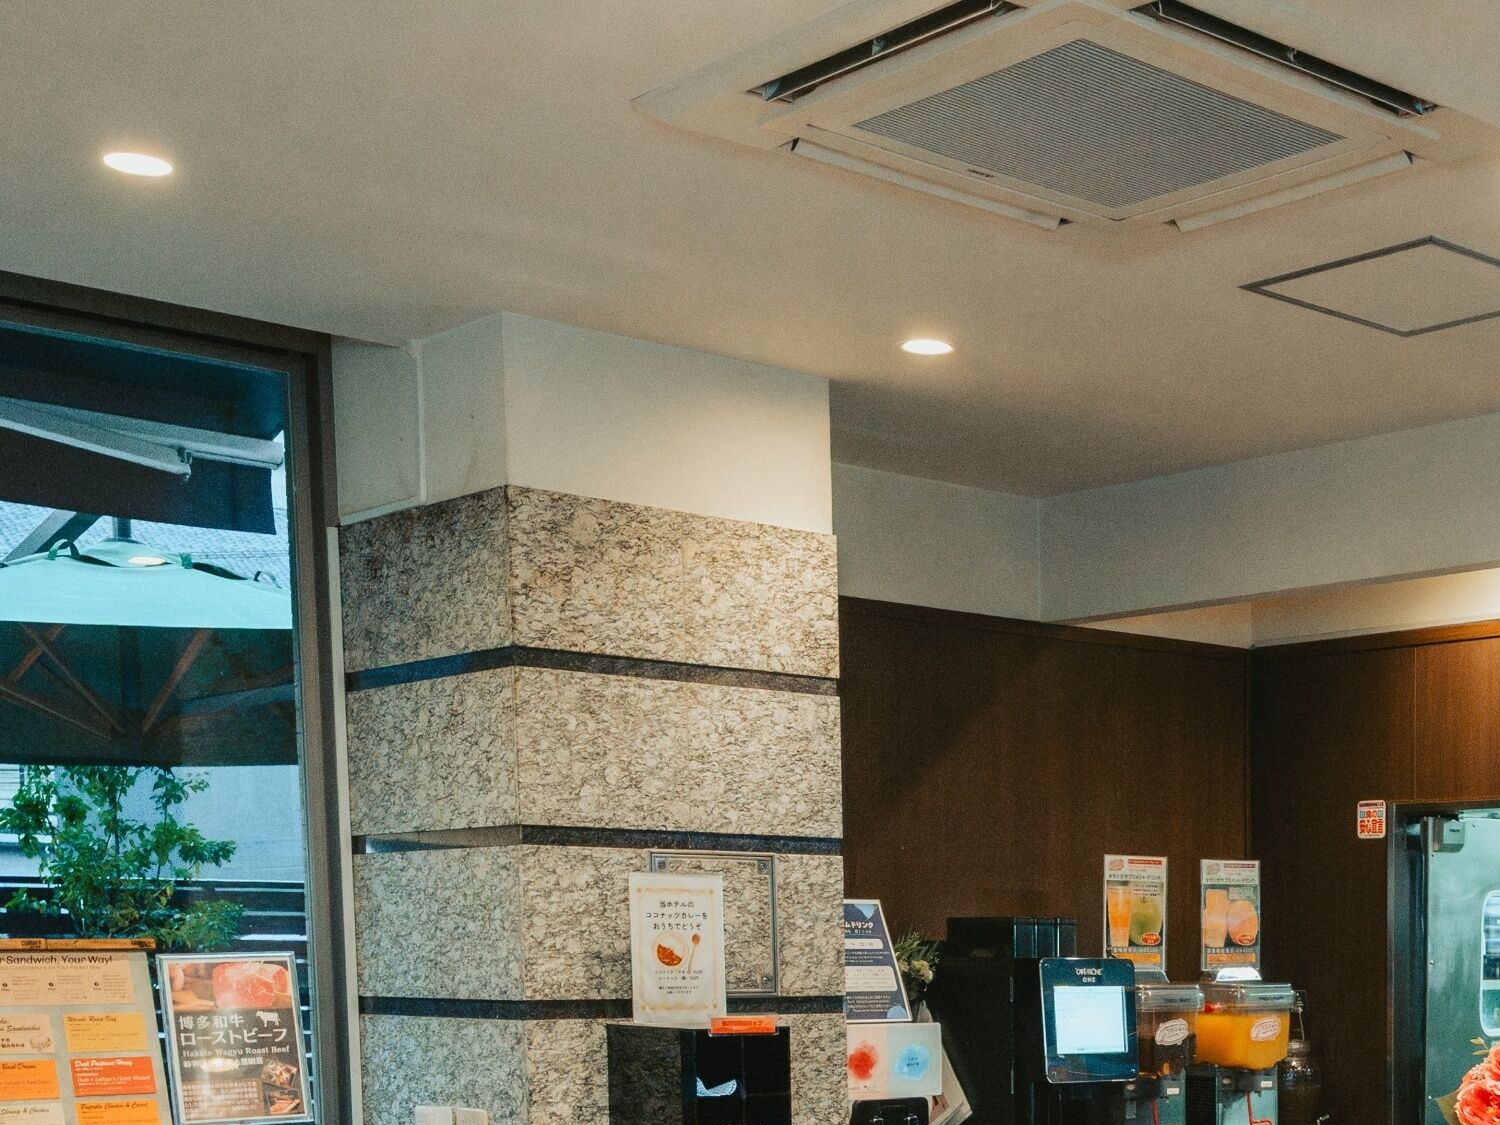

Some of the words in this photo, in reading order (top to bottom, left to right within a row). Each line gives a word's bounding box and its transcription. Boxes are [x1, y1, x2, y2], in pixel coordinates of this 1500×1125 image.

[659, 900, 695, 909] 当ホテルの
[646, 911, 708, 920] ココナッツカレーを
[653, 922, 702, 931] おうちでどうぞ
[6, 955, 60, 965] Sandwich,
[61, 955, 87, 964] Your
[88, 955, 113, 965] Way!
[178, 1013, 244, 1030] 博多和牛
[180, 1027, 288, 1046] ローストビーフ
[183, 1049, 212, 1058] Hakata
[214, 1047, 243, 1057] Wagyu
[245, 1047, 269, 1055] Roast
[271, 1045, 290, 1053] Beef
